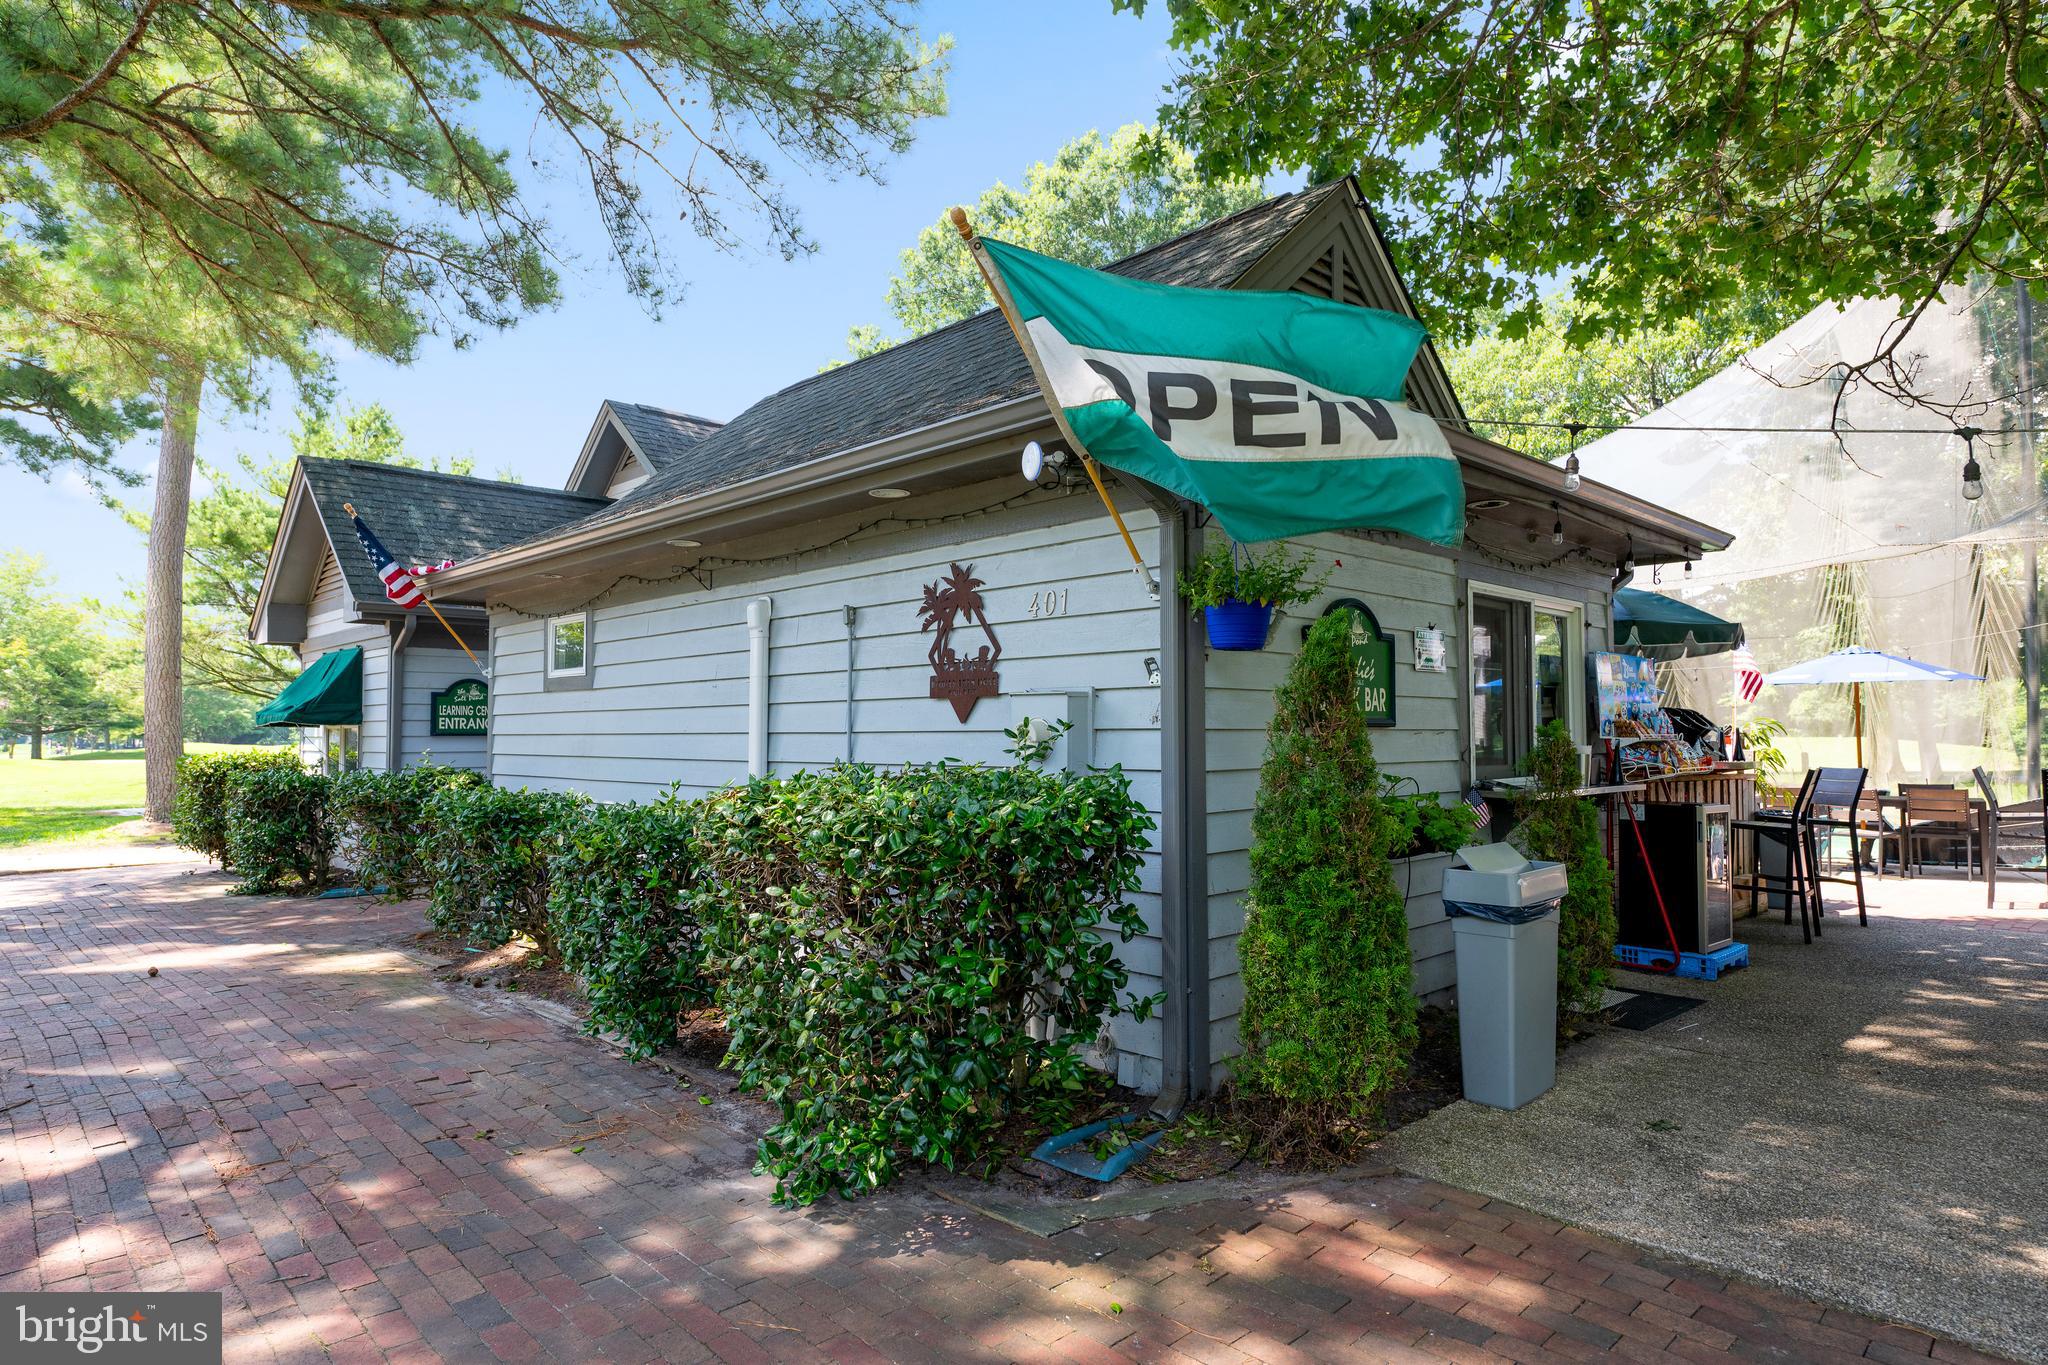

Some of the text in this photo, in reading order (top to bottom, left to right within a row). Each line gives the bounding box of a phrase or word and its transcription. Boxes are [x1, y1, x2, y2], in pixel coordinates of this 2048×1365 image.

[1028, 588, 1068, 618] 401
[1355, 656, 1376, 681] lie's
[439, 705, 488, 716] LEARNING CEN
[1364, 687, 1386, 712] BAR
[439, 717, 488, 729] ENTRAN
